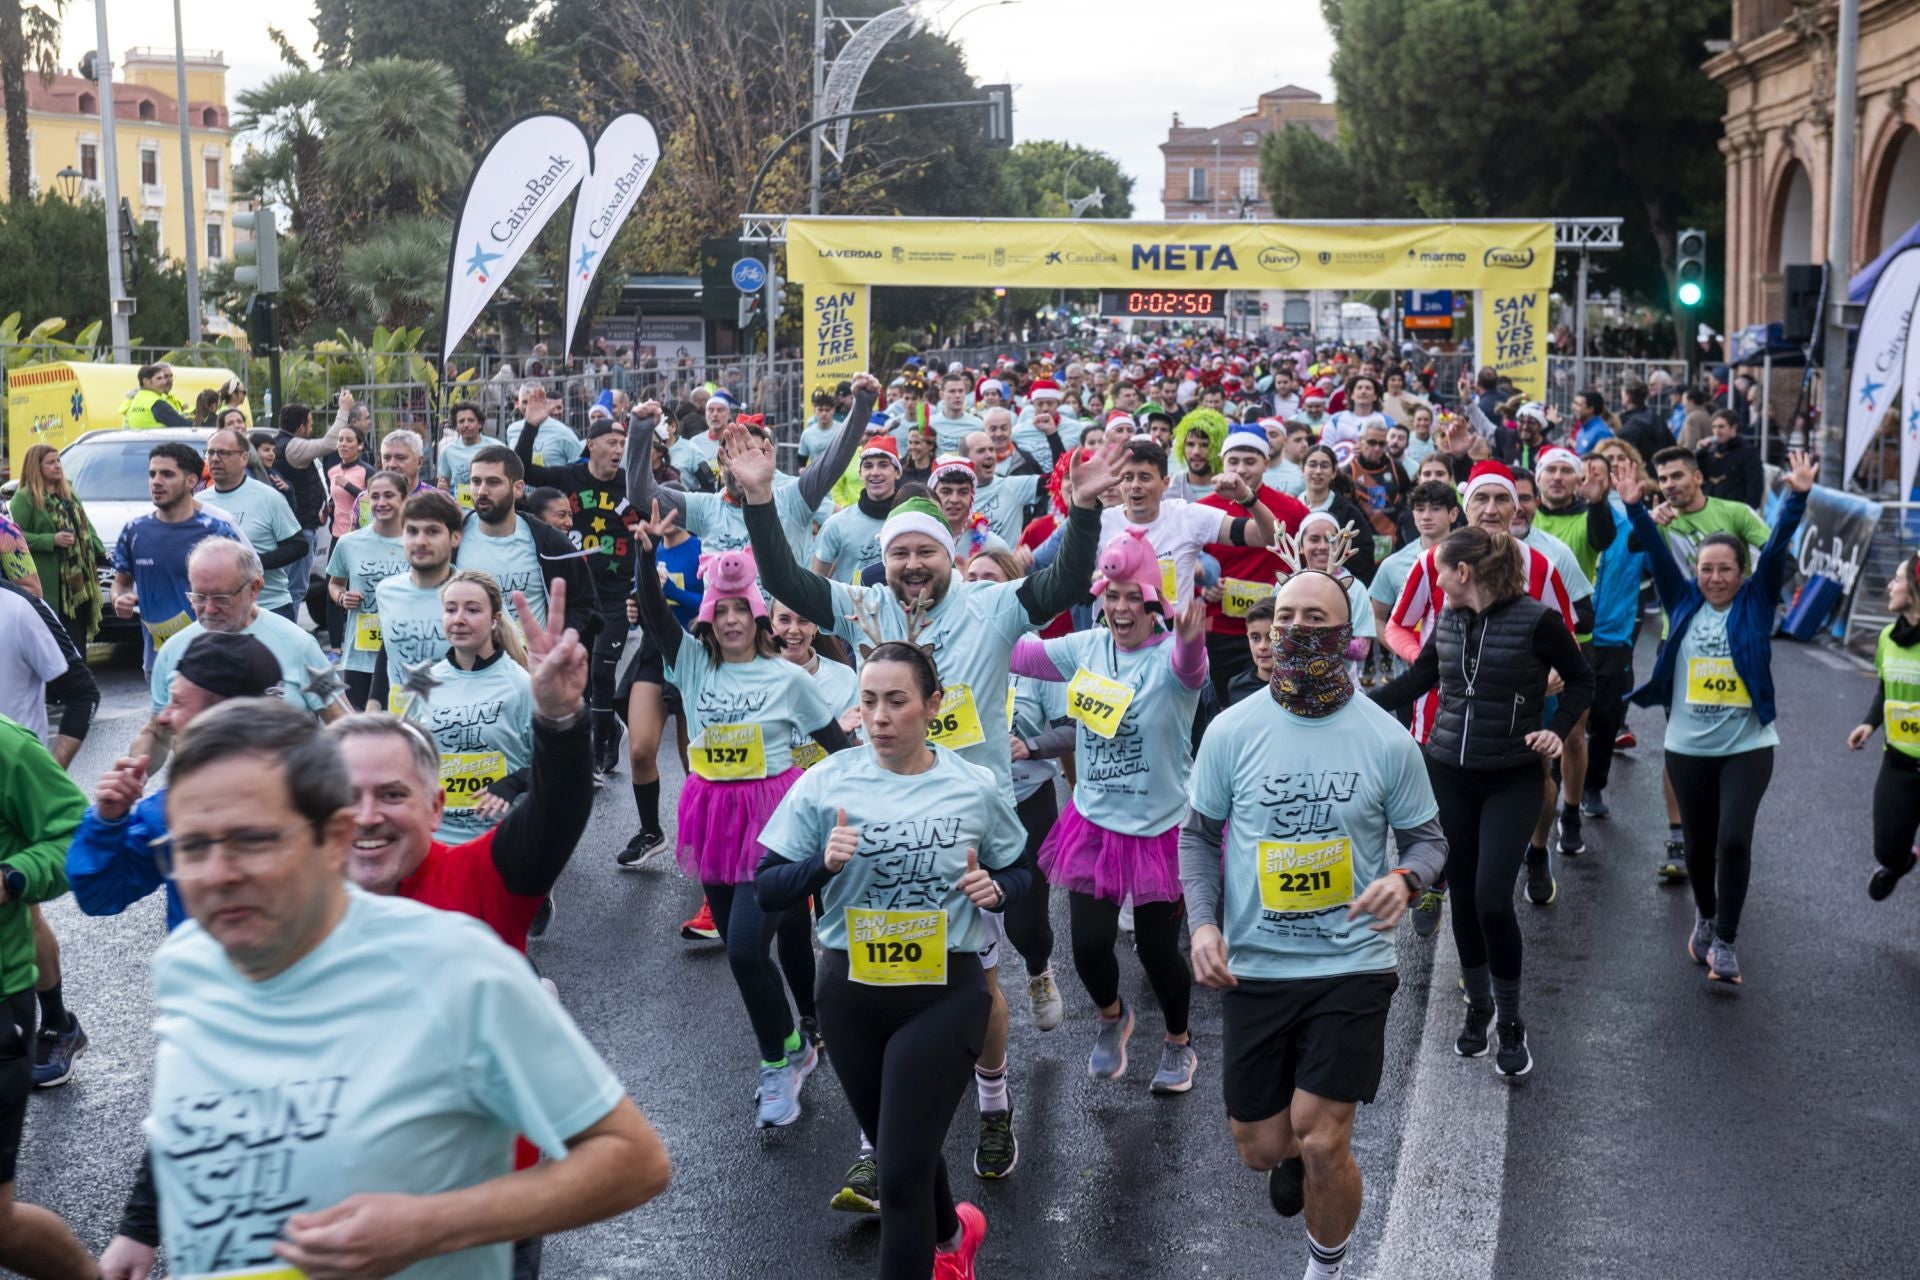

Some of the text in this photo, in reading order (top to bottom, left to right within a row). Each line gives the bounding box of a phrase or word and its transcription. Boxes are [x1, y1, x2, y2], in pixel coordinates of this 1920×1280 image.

[490, 153, 570, 243] CaixaBank
[589, 152, 650, 240] CaixaBank
[818, 249, 882, 259] LA VERDAD
[1131, 244, 1238, 270] META
[1262, 253, 1296, 265] Juver
[1420, 253, 1466, 262] marmo
[815, 292, 856, 311] SAN
[1129, 293, 1212, 313] 0:02:50
[1494, 294, 1536, 314] SAN
[821, 309, 849, 326] SIL
[1500, 311, 1529, 329] SIL
[818, 322, 853, 341] VES
[1496, 325, 1533, 343] VES
[818, 338, 855, 356] TRE
[1496, 341, 1533, 360] TRE
[816, 352, 858, 367] MURCIA
[1495, 356, 1537, 370] MURCIA
[568, 530, 628, 556] 2025
[1703, 679, 1737, 692] 403
[697, 688, 768, 712] SAN
[1074, 692, 1114, 719] 3877
[432, 700, 504, 733] SAN
[927, 714, 958, 736] 96
[705, 748, 748, 763] 1327
[1084, 737, 1143, 766] TRE
[1087, 760, 1149, 781] MURCIA
[1260, 772, 1361, 807] SAN
[1271, 803, 1338, 838] SIL
[858, 817, 962, 857] SAN
[1266, 847, 1296, 861] SAN
[1266, 842, 1344, 873] SILVESTRE
[871, 851, 943, 889] SIL
[1279, 871, 1331, 892] 2211
[854, 914, 886, 929] SAN
[854, 915, 939, 943] SILVESTRE
[866, 942, 922, 963] 1120
[163, 1075, 349, 1161] SAN
